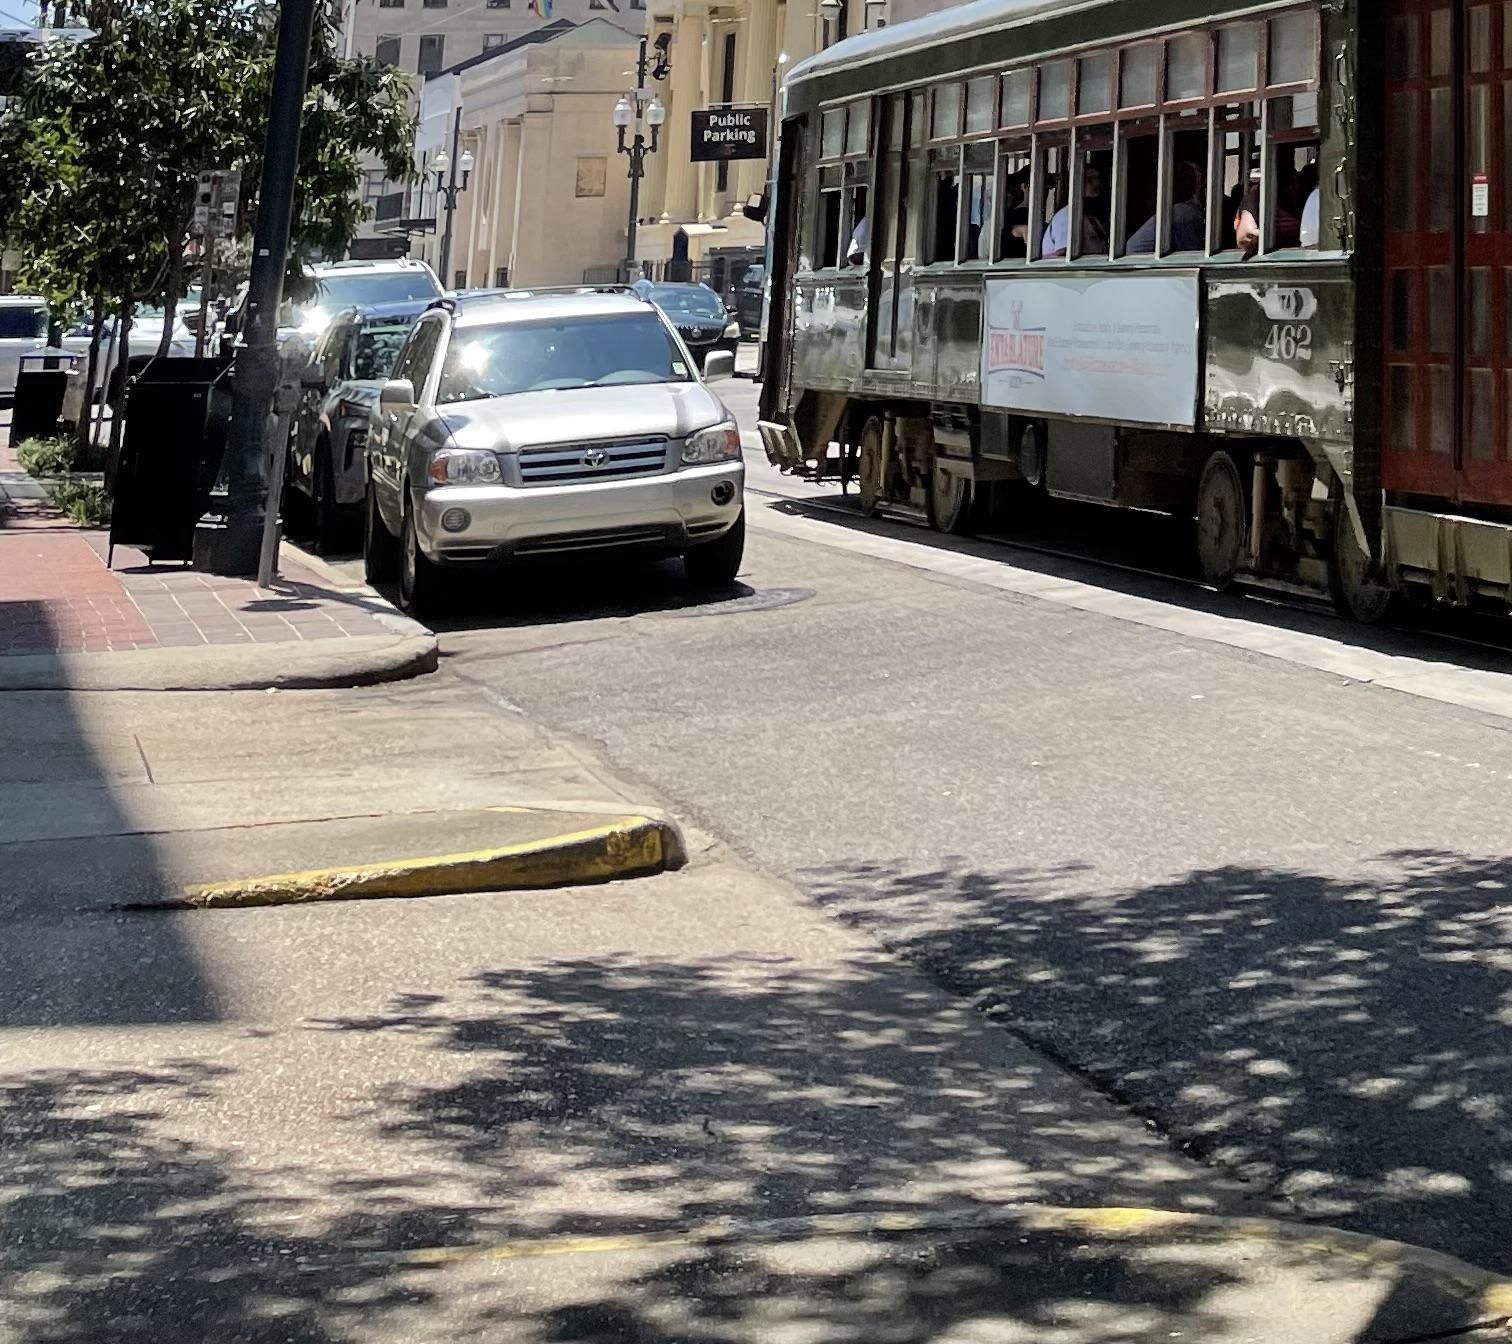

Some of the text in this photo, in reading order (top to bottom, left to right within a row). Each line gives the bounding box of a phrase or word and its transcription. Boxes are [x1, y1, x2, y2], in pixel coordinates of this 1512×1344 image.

[709, 113, 751, 127] Public
[703, 128, 756, 144] Parking
[1264, 324, 1312, 361] 462
